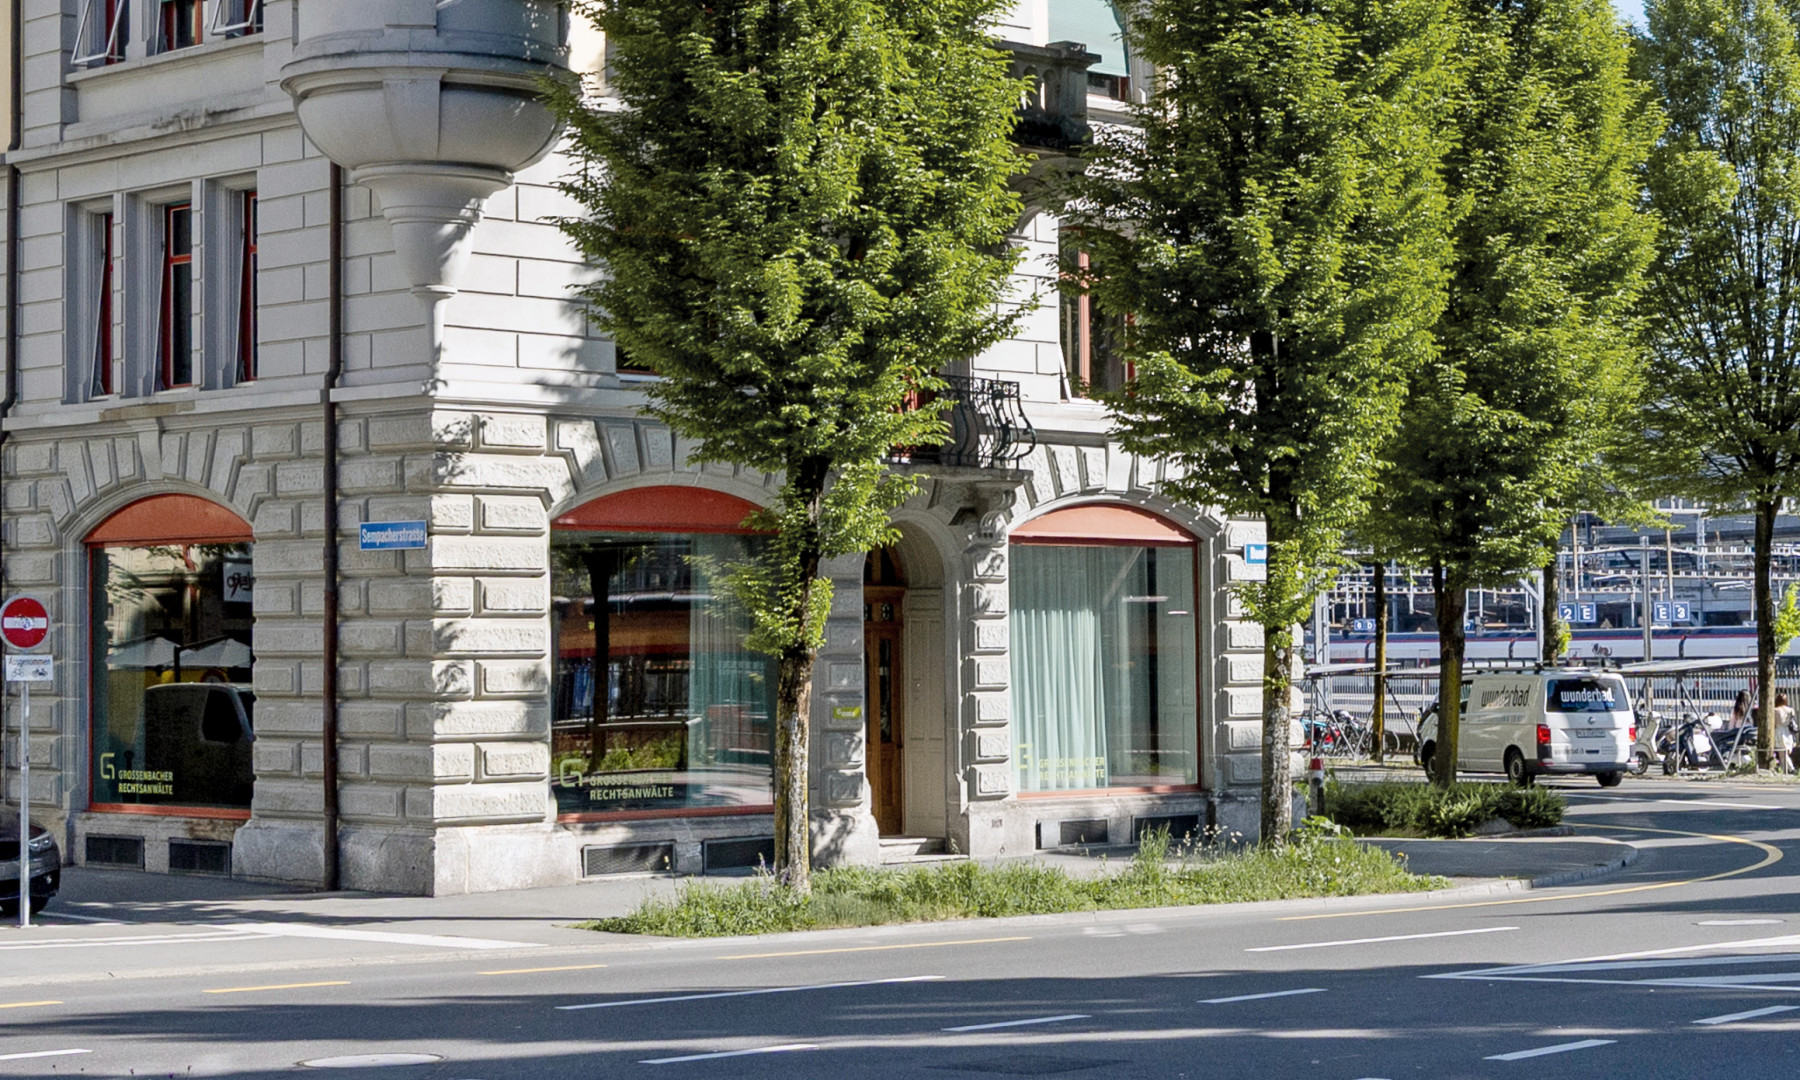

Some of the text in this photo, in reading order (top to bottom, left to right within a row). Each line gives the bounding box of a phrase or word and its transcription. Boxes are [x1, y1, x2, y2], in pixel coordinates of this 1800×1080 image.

[362, 527, 424, 546] Sempacherstrasse
[1563, 608, 1591, 620] 2 E
[1659, 607, 1686, 619] E 3
[1560, 687, 1616, 702] wunderbad.
[118, 770, 174, 781] GROSSENBACHER
[118, 783, 174, 795] RECHTSANWÄLTE
[590, 785, 673, 801] RECHTSANWÄLTE
